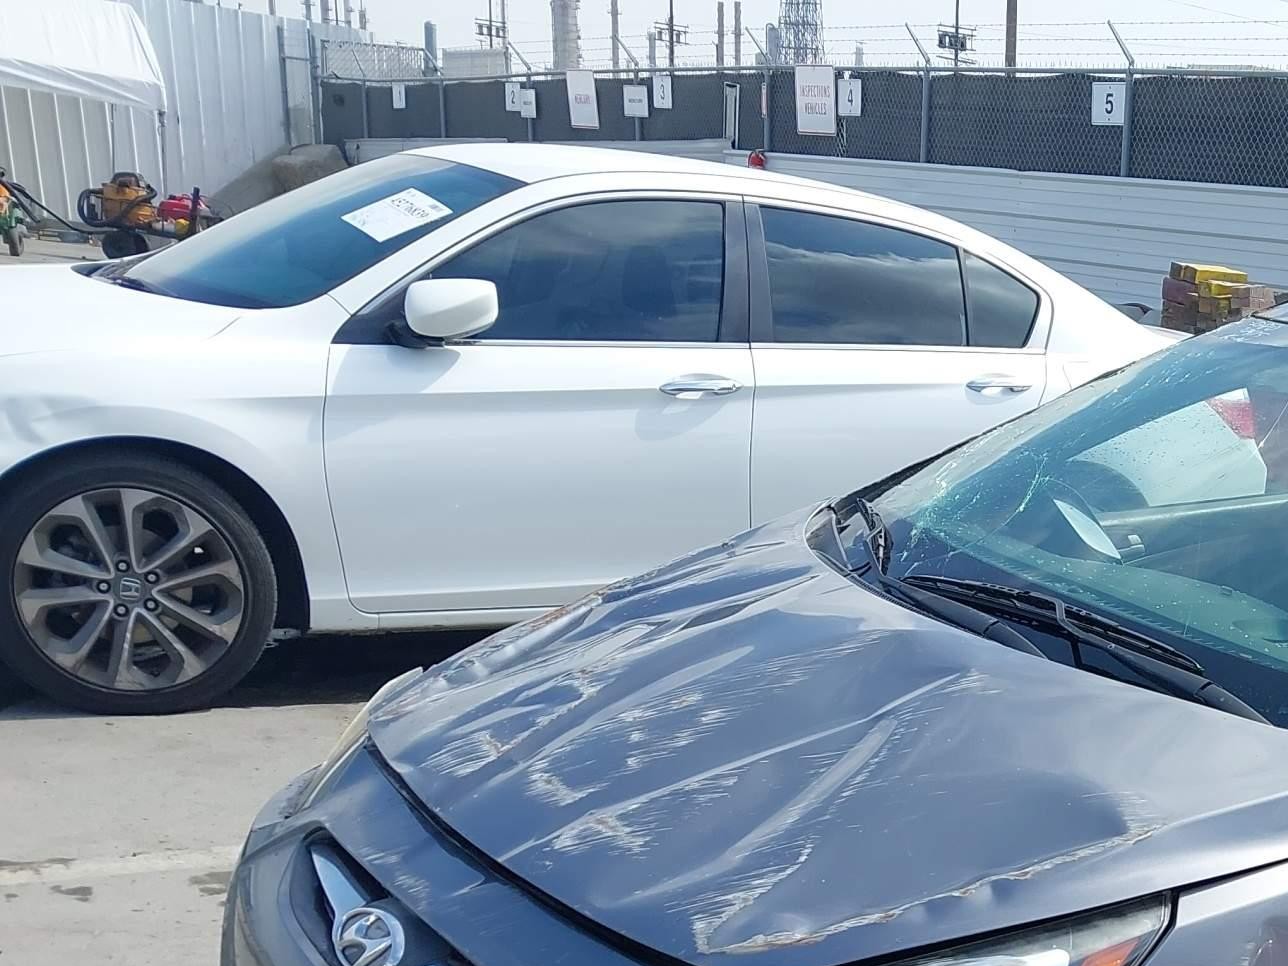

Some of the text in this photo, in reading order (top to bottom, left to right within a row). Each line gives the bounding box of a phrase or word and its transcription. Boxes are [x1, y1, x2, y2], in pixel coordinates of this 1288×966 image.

[510, 90, 516, 105] 2
[659, 83, 665, 101] 3
[800, 85, 830, 97] INSPECTIONS
[847, 88, 854, 107] 4
[804, 103, 827, 115] VEHICLES
[1105, 93, 1114, 115] 5
